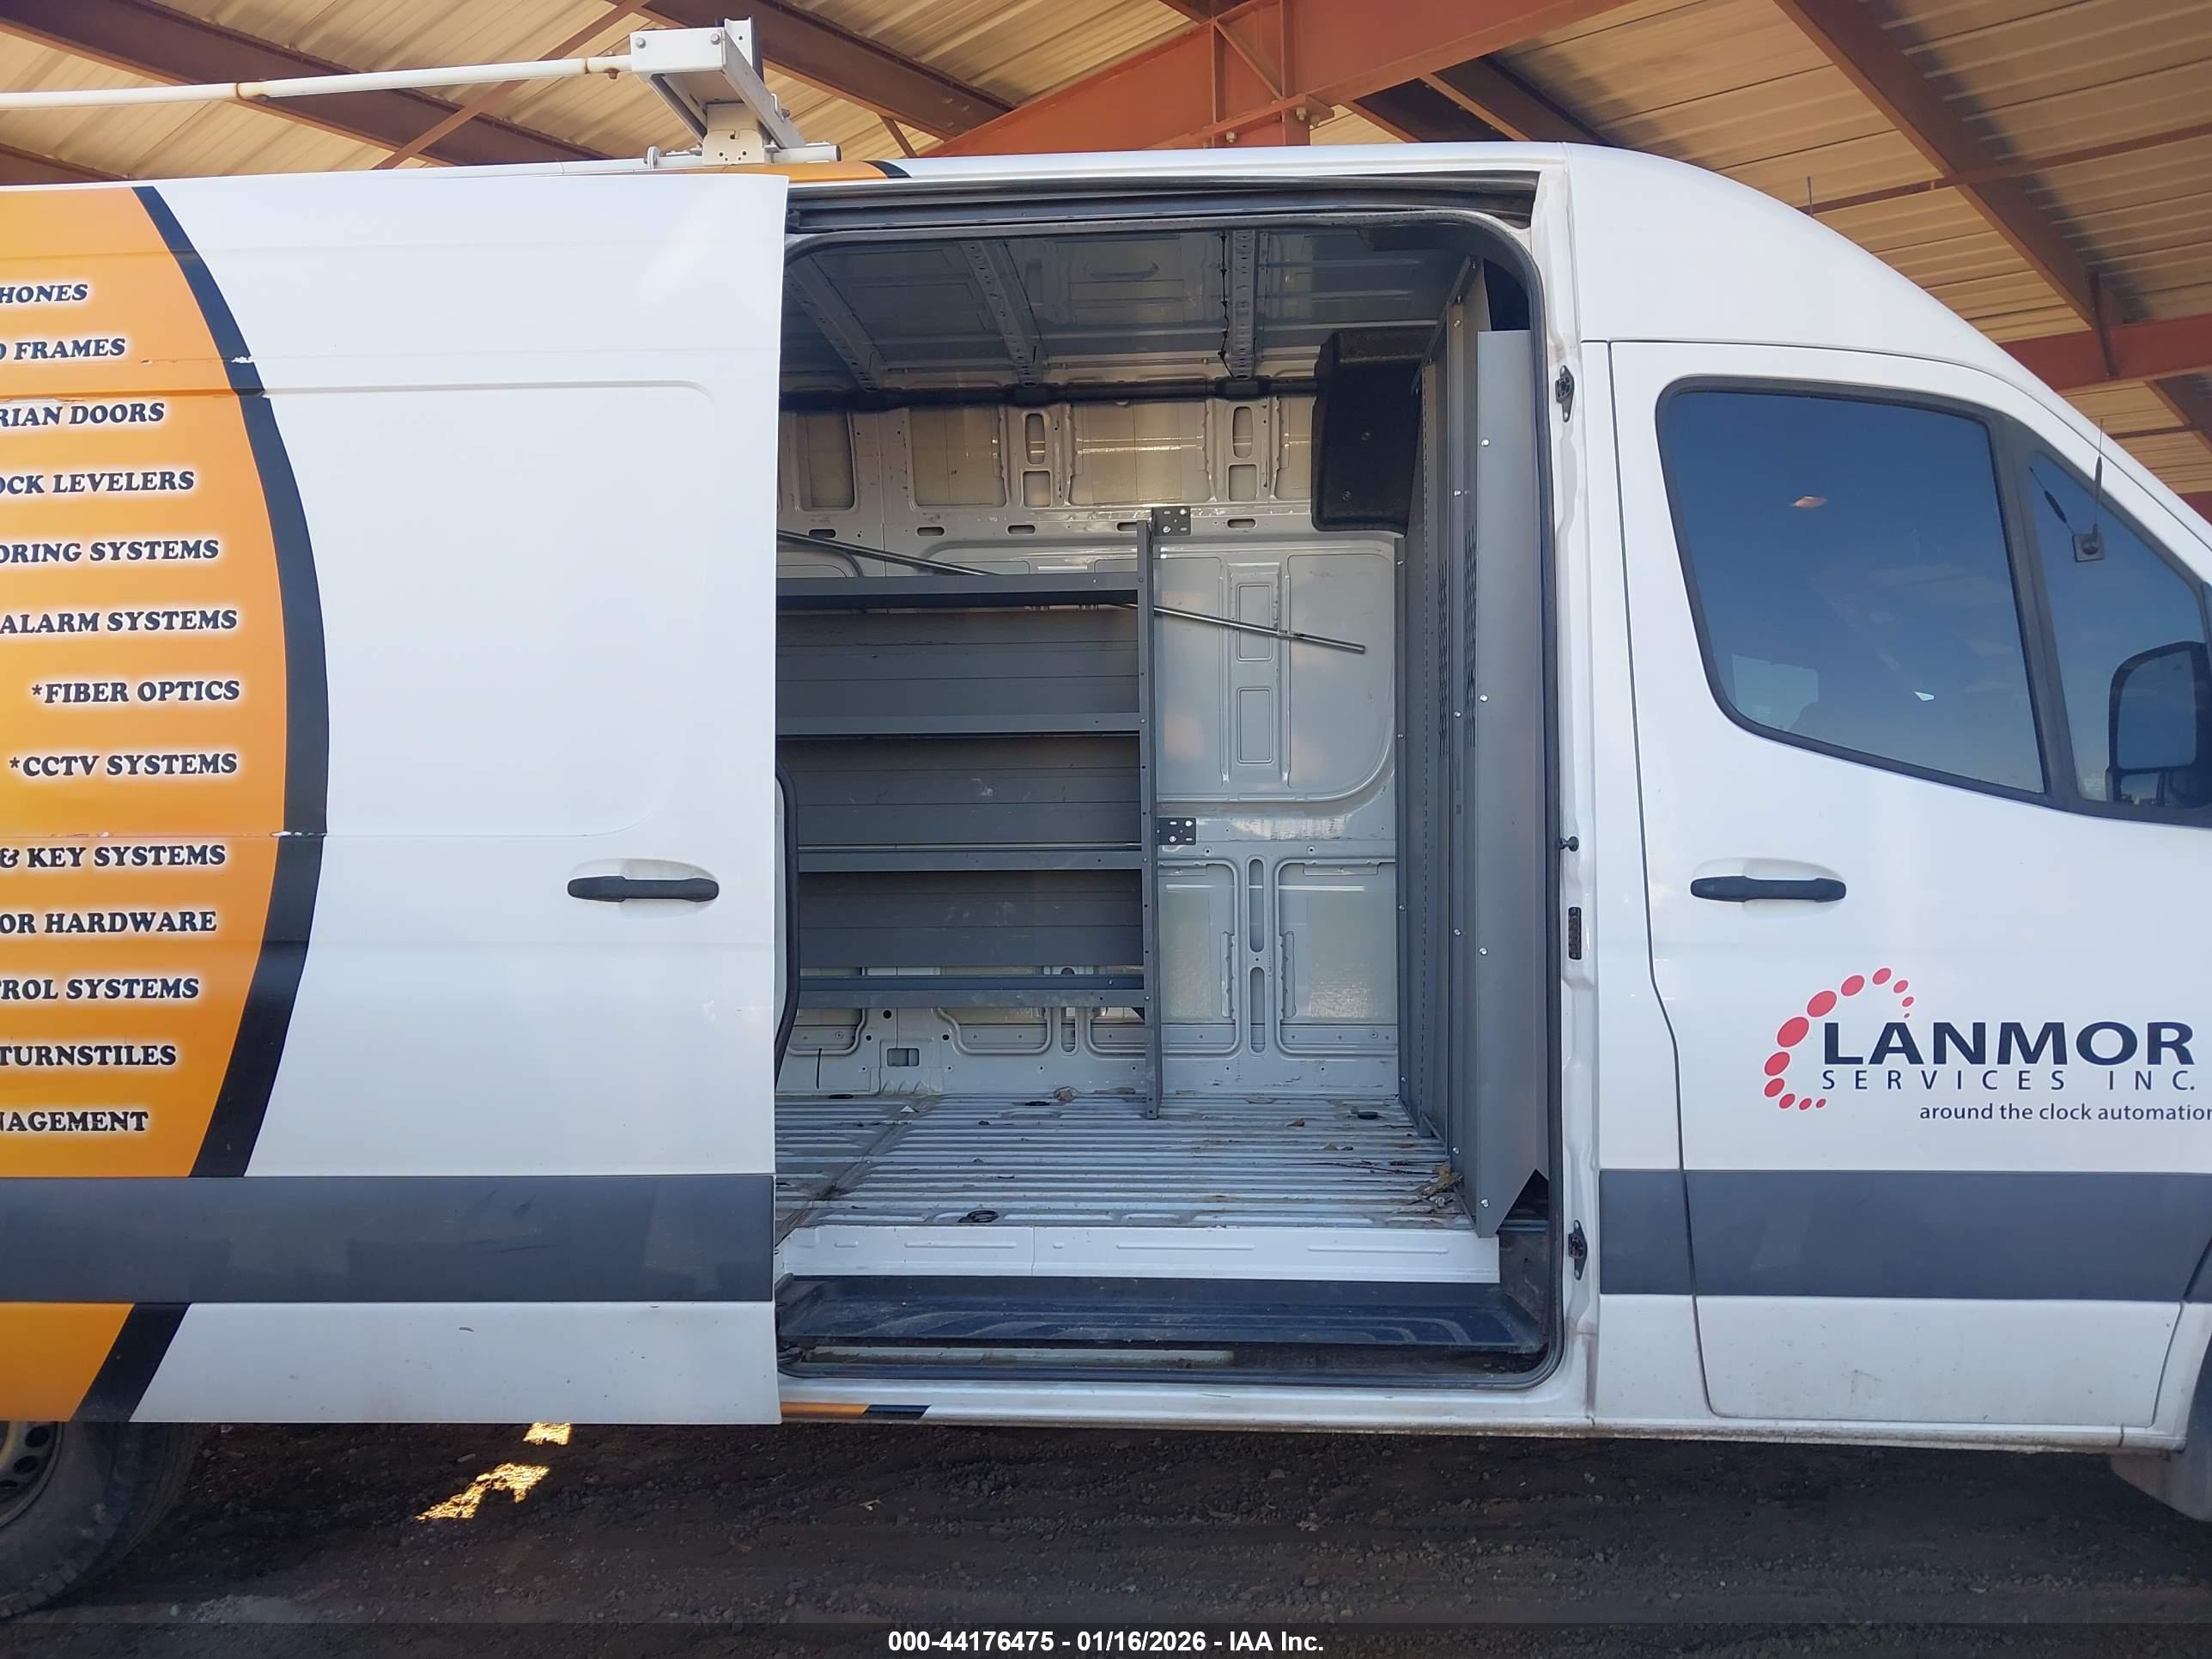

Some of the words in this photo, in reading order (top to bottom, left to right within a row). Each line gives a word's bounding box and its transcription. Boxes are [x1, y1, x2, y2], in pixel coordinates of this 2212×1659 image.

[14, 337, 125, 361] FRAMES
[69, 402, 165, 424] DOORS
[52, 471, 194, 493] LEVELERS
[89, 539, 219, 562] SYSTEMS
[0, 612, 100, 635] ALARM
[106, 610, 237, 632] SYSTEMS
[137, 680, 240, 702] OPTICS
[106, 753, 237, 775] SYSTEMS
[27, 847, 87, 868] KEY
[94, 844, 226, 867] SYSTEMS
[0, 913, 37, 934] OR
[44, 910, 217, 933] HARDWARE
[0, 979, 59, 1000] ROL
[65, 977, 199, 1000] SYSTEMS
[1824, 1021, 2195, 1066] LANMOR
[0, 1044, 177, 1066] TURNSTILES
[1822, 1070, 2064, 1091] SERVICES
[2109, 1070, 2195, 1091] INC.
[0, 1111, 149, 1132] AGEMENT
[1920, 1103, 1993, 1120] around
[2000, 1103, 2033, 1120] the
[2039, 1103, 2092, 1120] clock
